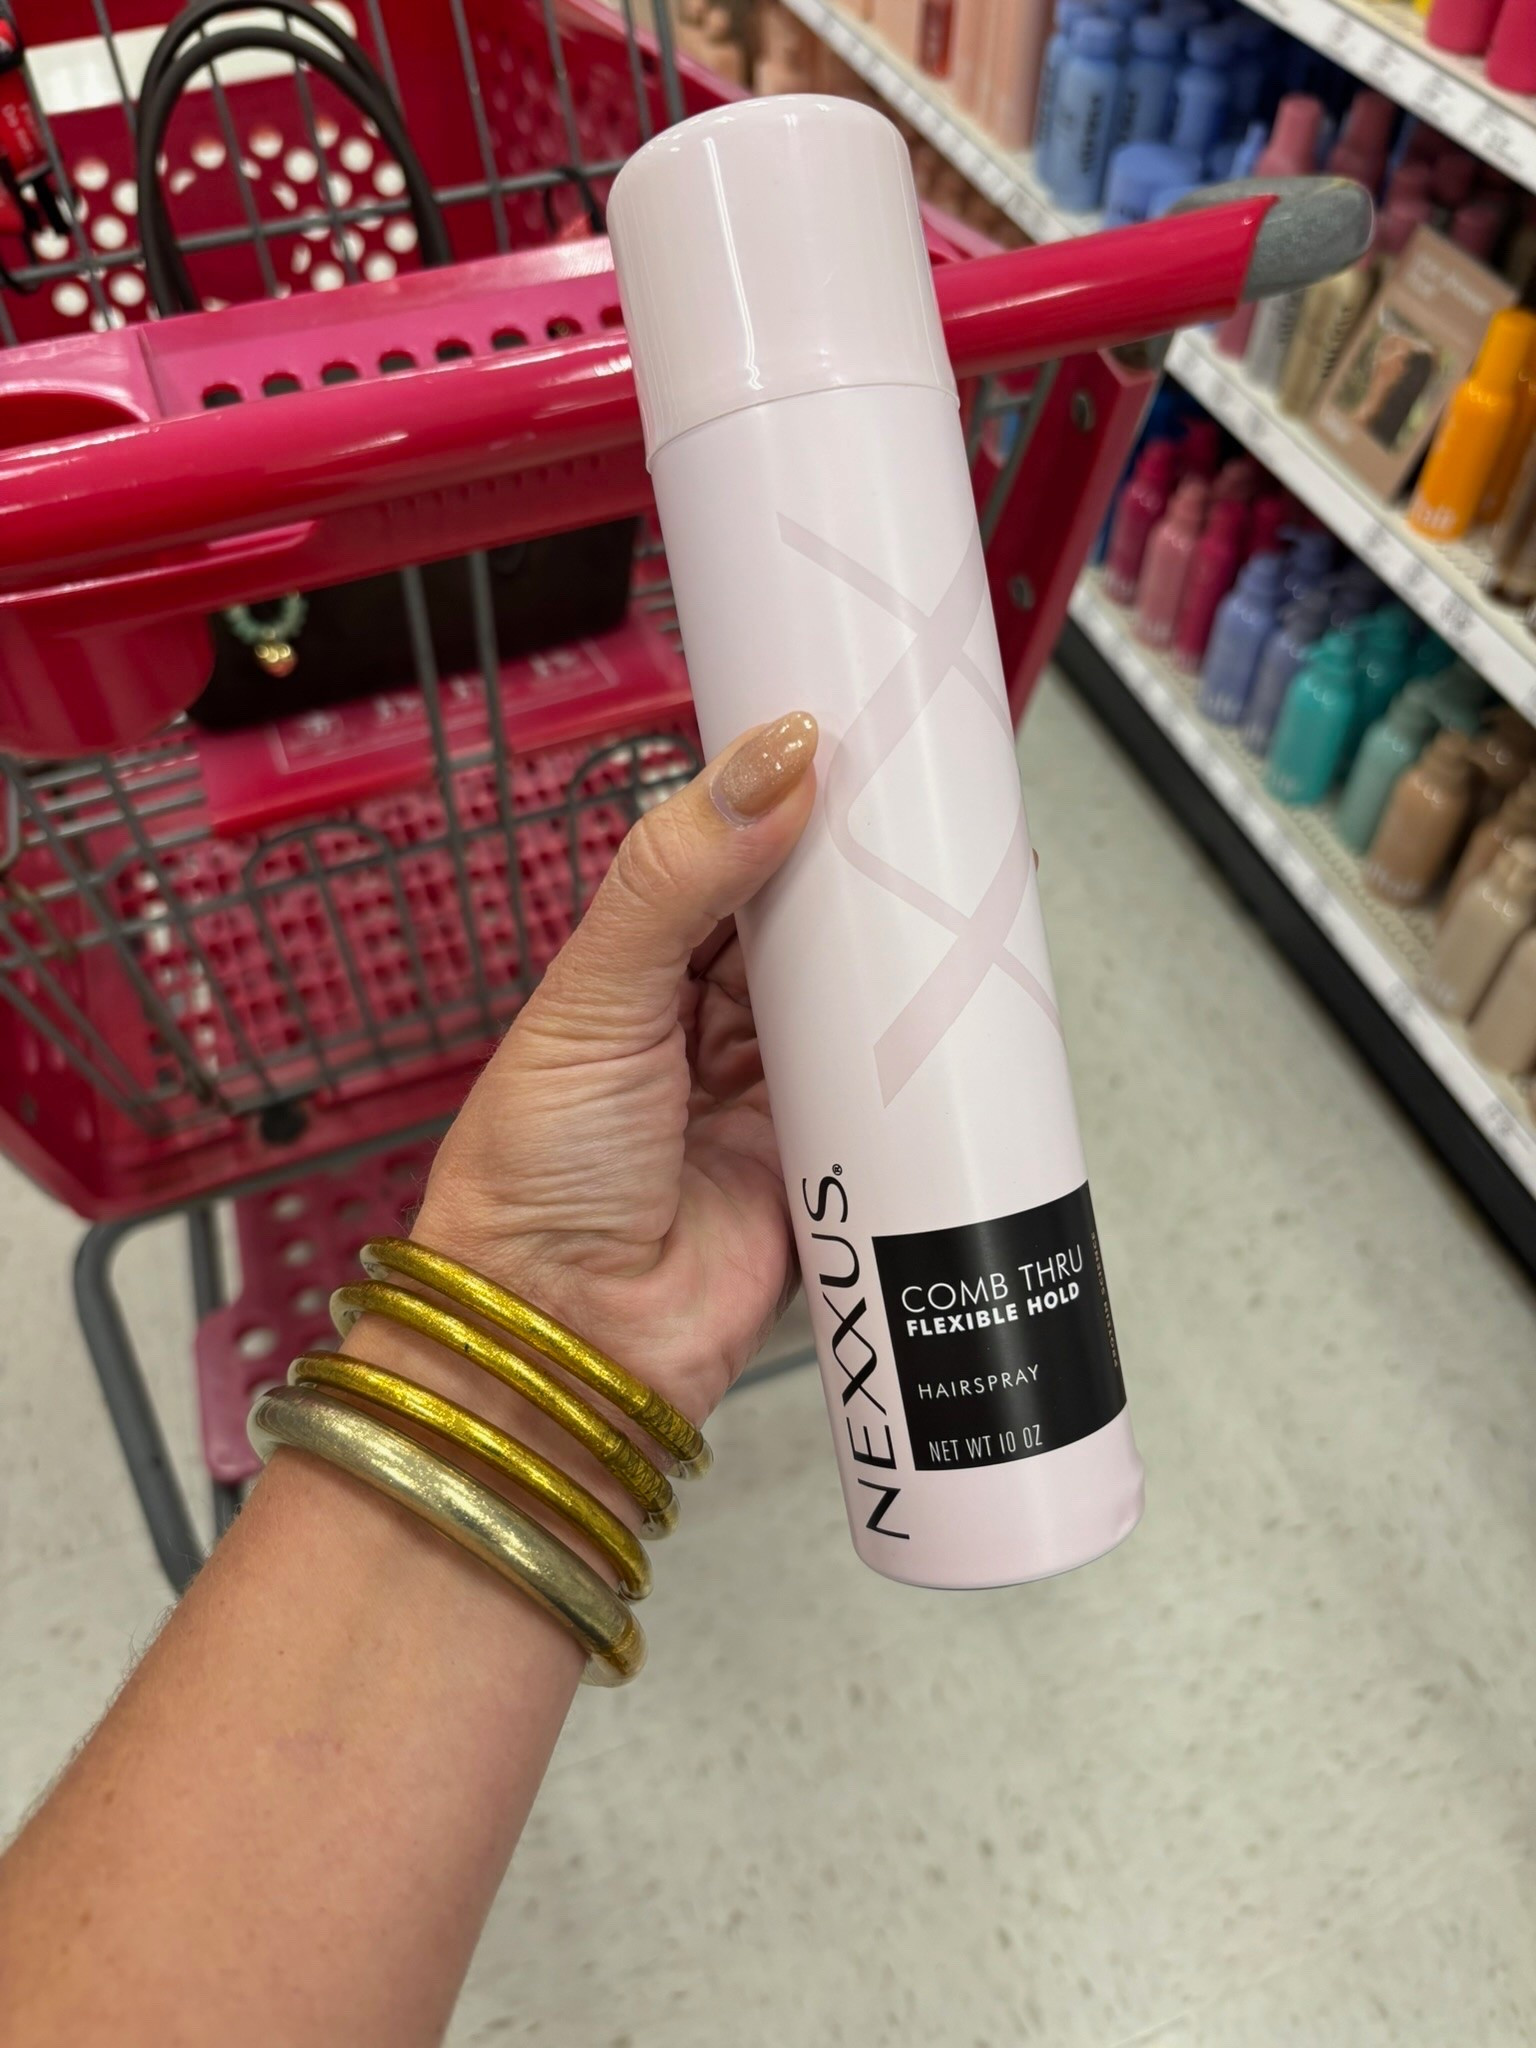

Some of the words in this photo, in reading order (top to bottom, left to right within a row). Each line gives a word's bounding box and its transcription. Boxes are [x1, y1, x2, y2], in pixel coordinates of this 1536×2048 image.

[901, 1272, 1009, 1314] COMB
[1017, 1243, 1084, 1292] THRU
[906, 1302, 1019, 1337] FLEXIBLE
[1026, 1281, 1080, 1316] HOLD
[917, 1363, 1040, 1400] HAIRSPRAY
[928, 1439, 959, 1463] NET
[965, 1435, 992, 1460] WT
[999, 1431, 1017, 1455] 10
[1022, 1423, 1044, 1449] OZ
